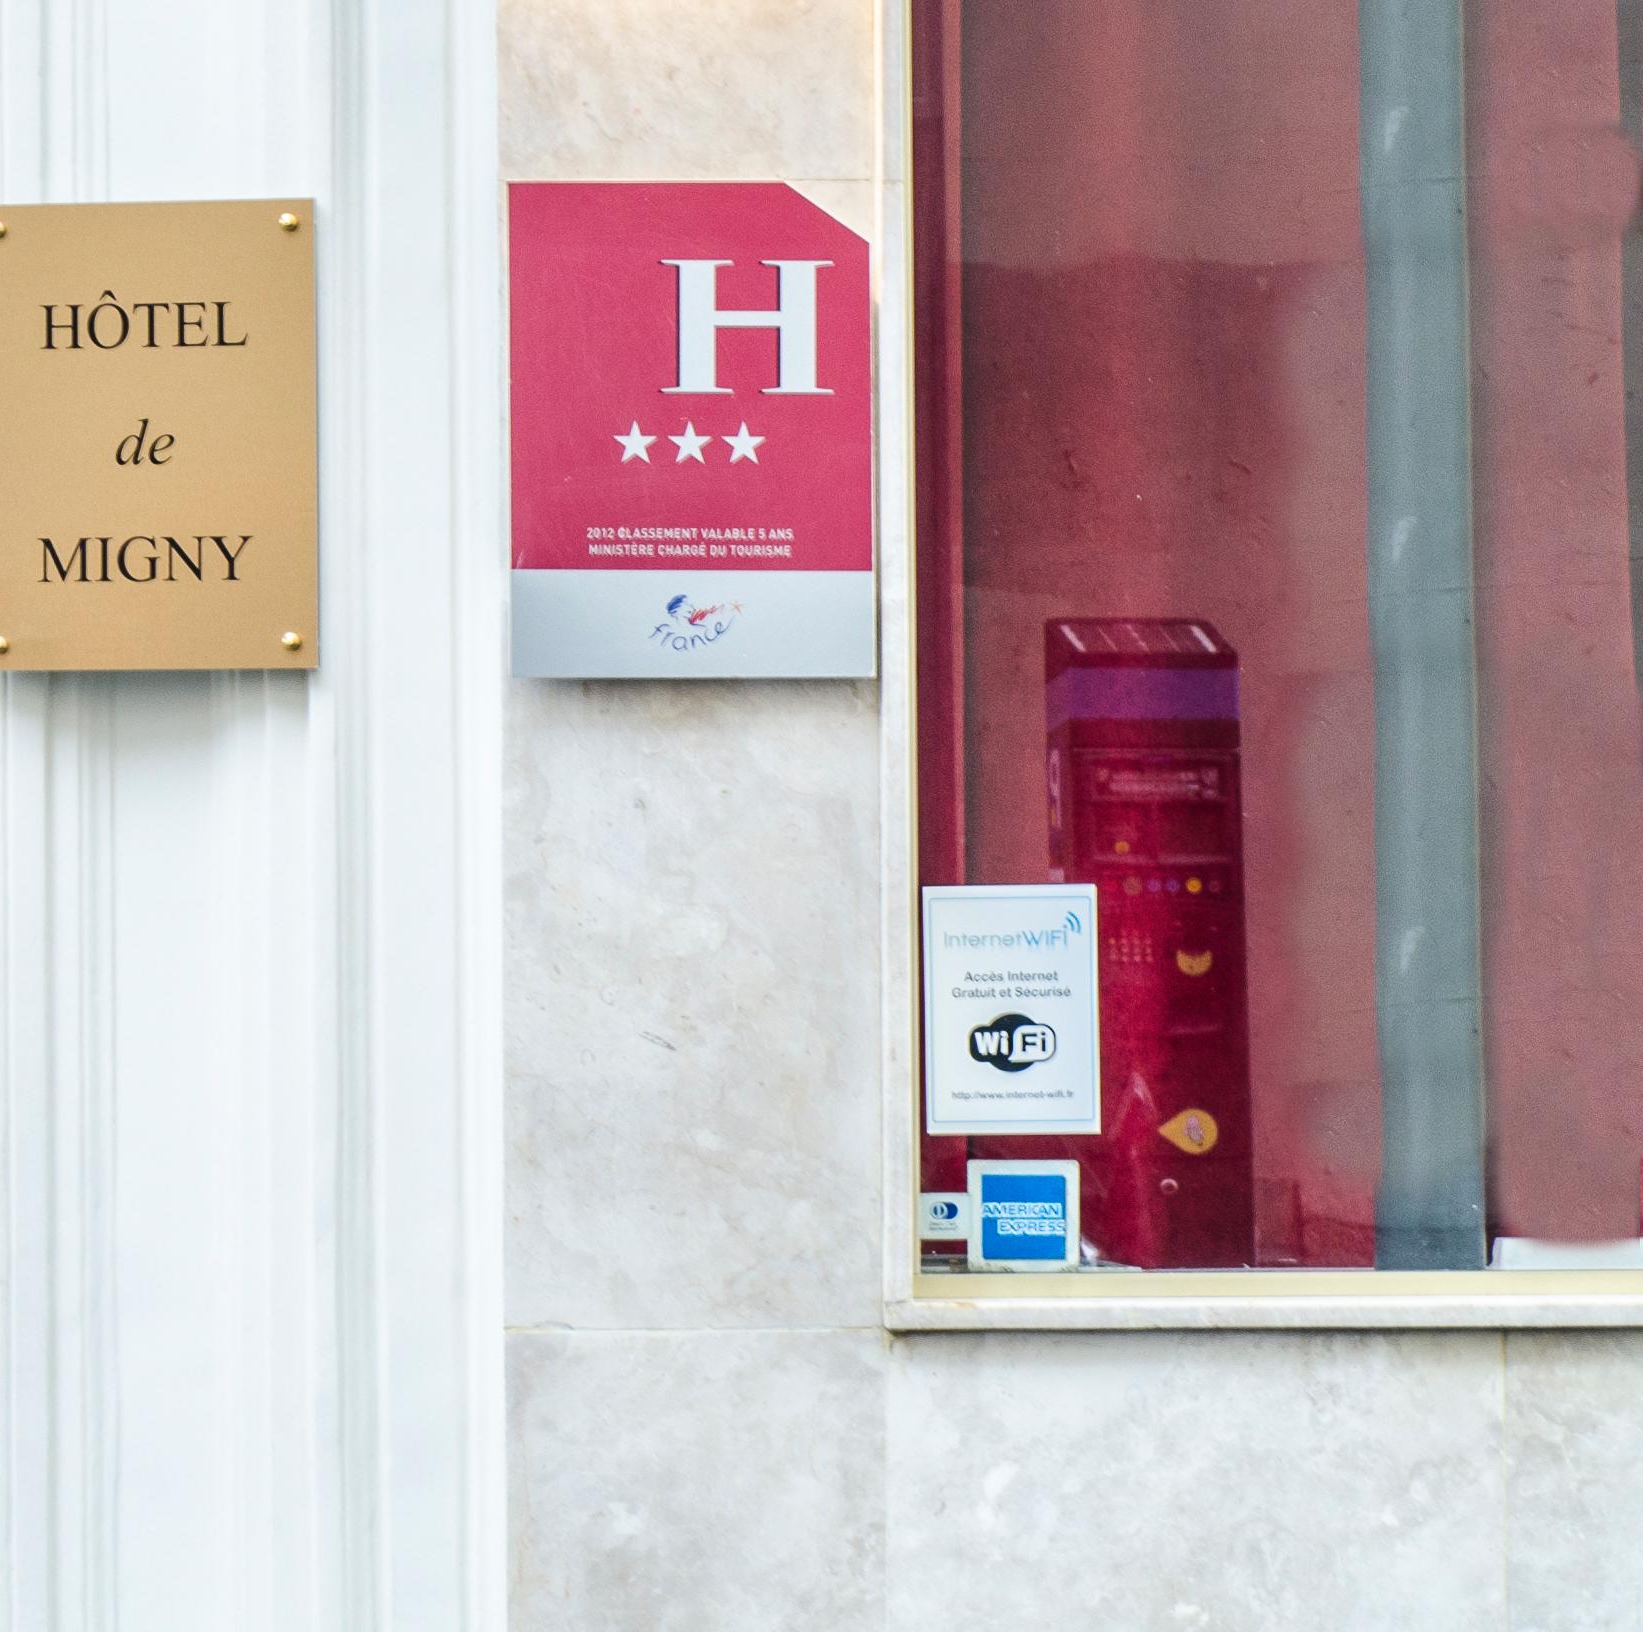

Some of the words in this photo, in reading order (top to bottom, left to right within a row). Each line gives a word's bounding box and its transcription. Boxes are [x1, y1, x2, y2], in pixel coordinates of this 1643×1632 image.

[39, 289, 249, 351] HÔTEL
[659, 258, 835, 396] H
[115, 418, 176, 466] de
[586, 527, 615, 540] 2012
[617, 526, 698, 540] CLASSEMENT
[701, 528, 755, 540] VALABLE
[757, 528, 767, 540] 5
[768, 528, 794, 540] ANS
[588, 541, 654, 556] MINISTÈRE
[657, 541, 707, 556] CHARGÉ
[709, 544, 728, 556] DU
[730, 544, 793, 556] TOURISME
[37, 534, 254, 584] MIGNY
[1007, 970, 1058, 982] Internet
[952, 986, 996, 999] Gratuit
[999, 986, 1012, 998] et
[982, 1203, 1060, 1217] AMERICAN
[999, 1220, 1067, 1232] EXPRESS
